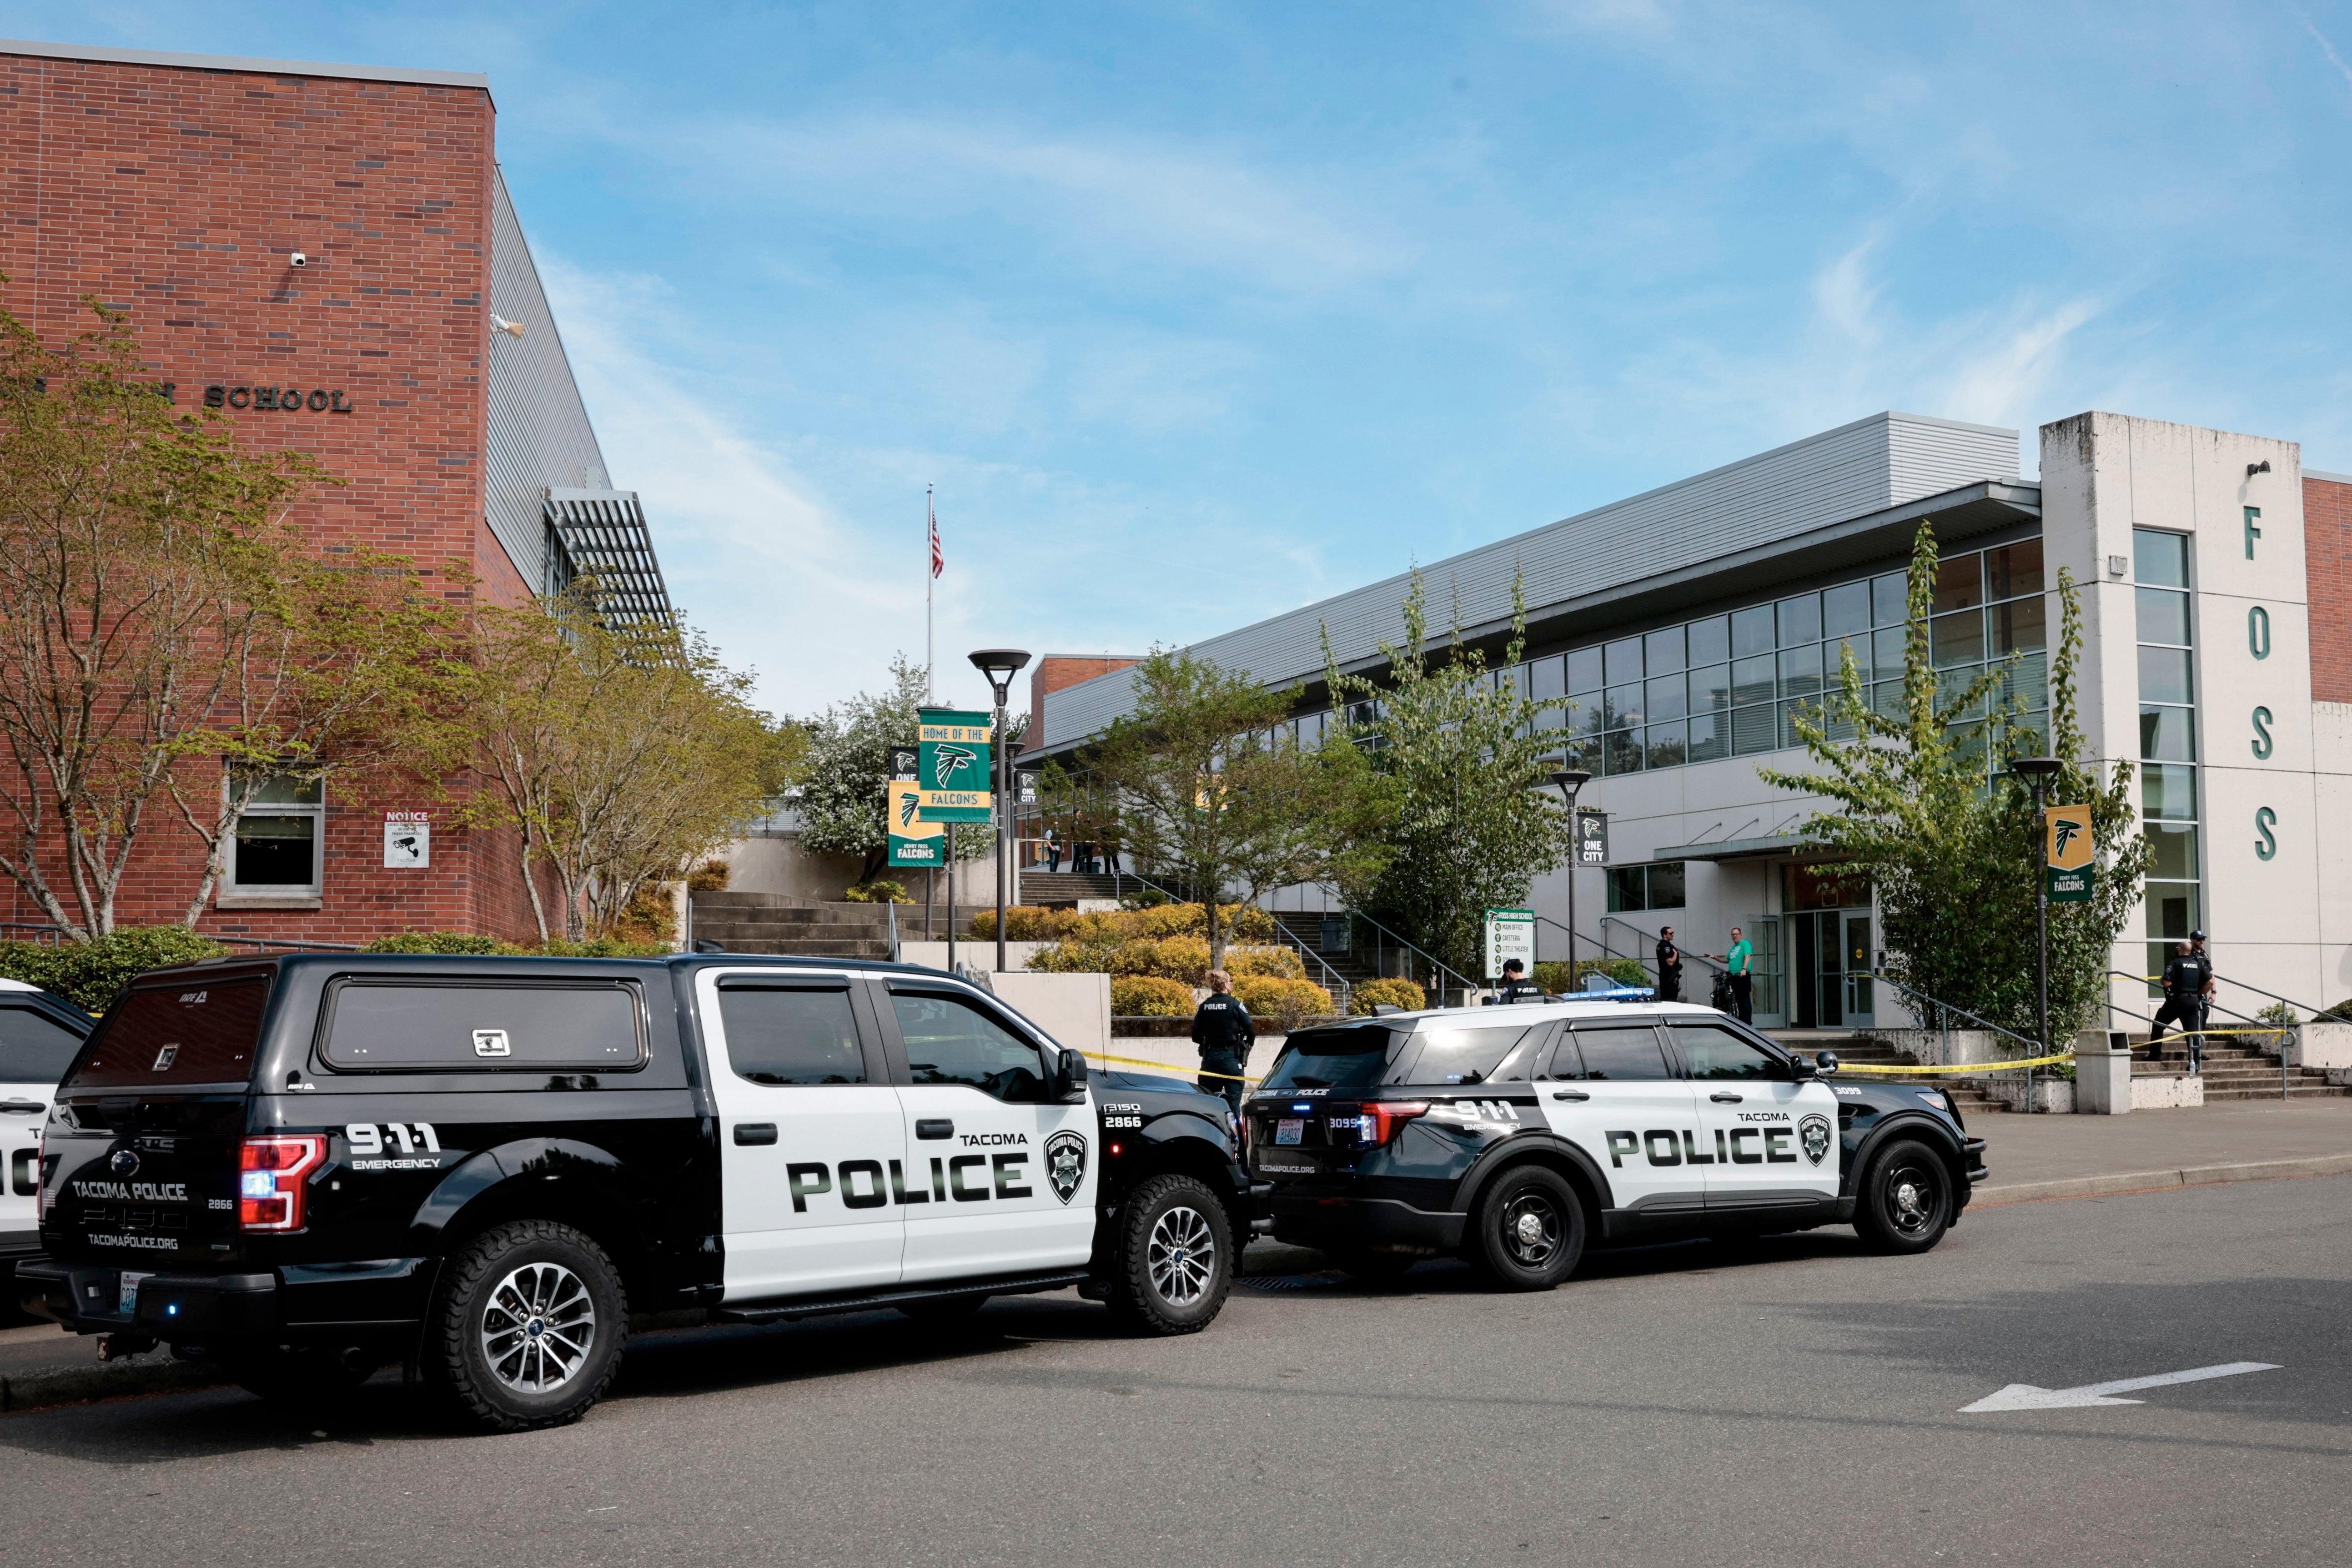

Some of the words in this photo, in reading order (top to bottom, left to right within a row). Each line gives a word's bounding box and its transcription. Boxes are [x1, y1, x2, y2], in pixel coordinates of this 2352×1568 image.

[205, 385, 353, 412] SCHOOL
[2243, 505, 2277, 862] FOSS
[924, 728, 948, 739] HOME
[952, 729, 962, 739] OF
[968, 729, 983, 740] THE
[931, 794, 977, 804] FALCONS
[387, 812, 427, 821] NOTICE
[1584, 840, 1602, 850] ONE
[897, 849, 934, 859] FALCONS
[1583, 851, 1603, 861] CITY
[2054, 880, 2085, 891] FALCONS
[1106, 1116, 1141, 1128] 2866
[1330, 1118, 1357, 1128] 3099
[1738, 1113, 1790, 1122] TACOMA
[1801, 1118, 1814, 1131] TACOMA
[1814, 1118, 1828, 1130] POLICE
[960, 1133, 1028, 1146] TACOMA
[1281, 1128, 1300, 1140] 814030
[1048, 1136, 1067, 1156] TACOMA
[1067, 1136, 1083, 1153] POLICE
[1605, 1127, 1797, 1168] POLICE
[352, 1159, 441, 1170] EMERGENCY
[1259, 1165, 1315, 1173] TACOMAPOLICE.ORG
[786, 1152, 1033, 1213] POLICE
[73, 1181, 131, 1199] TACOMA
[132, 1183, 188, 1201] POLICE
[208, 1199, 233, 1210] 2866
[88, 1234, 178, 1250] TACOMAPOLICE.ORG
